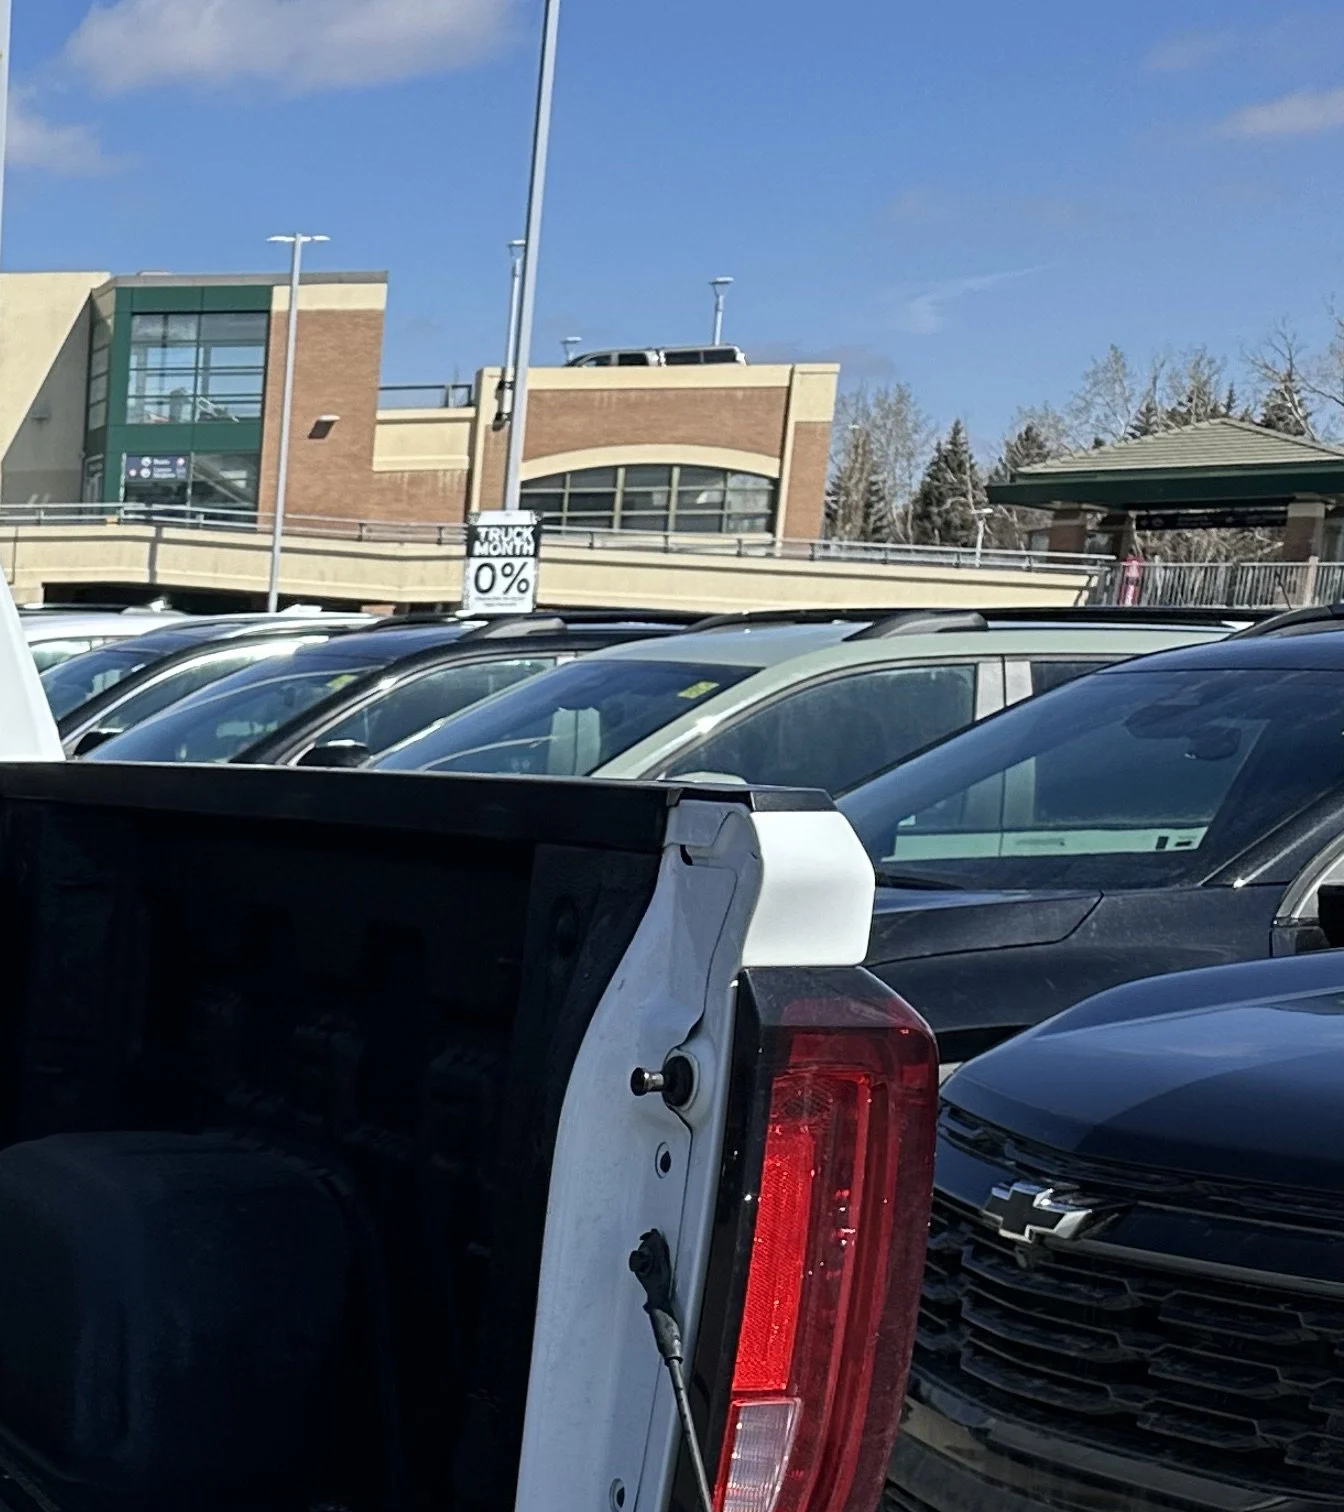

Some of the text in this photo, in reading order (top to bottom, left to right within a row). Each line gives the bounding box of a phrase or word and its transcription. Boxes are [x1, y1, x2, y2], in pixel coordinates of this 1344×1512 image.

[476, 526, 535, 541] TRUCK
[473, 540, 535, 556] MONTH
[474, 562, 530, 594] 0%
